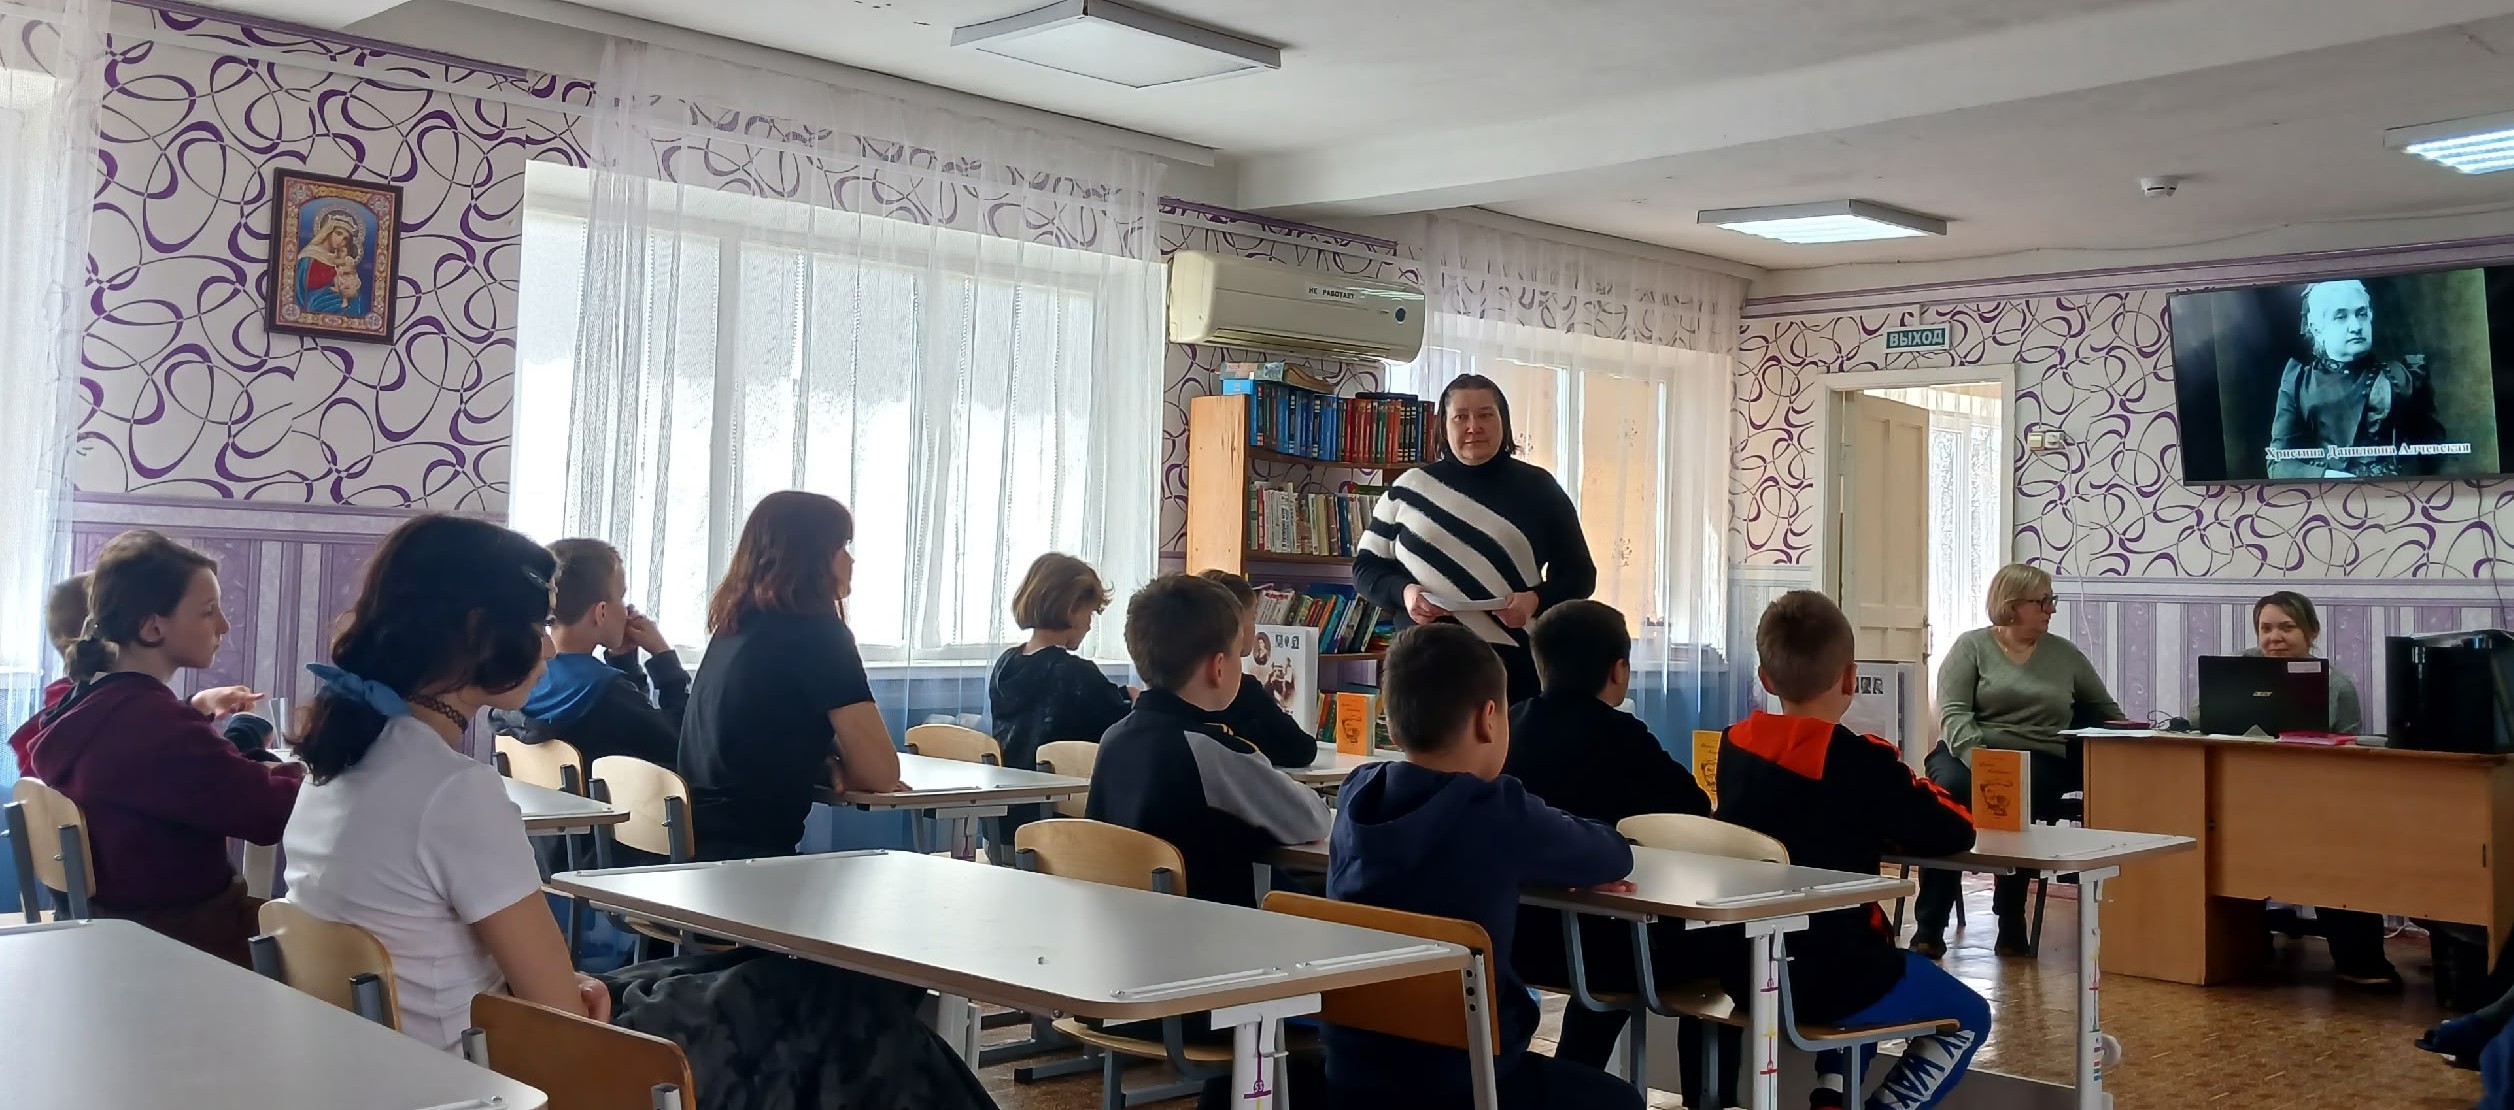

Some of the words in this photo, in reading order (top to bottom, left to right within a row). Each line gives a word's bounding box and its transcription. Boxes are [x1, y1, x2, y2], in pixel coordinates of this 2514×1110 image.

[1308, 287, 1318, 295] НЕ
[1322, 289, 1355, 299] РАБОТАЕТ
[1889, 329, 1944, 347] ВЫХОД
[2265, 447, 2325, 461] Христина
[2327, 445, 2397, 460] Даниловна
[2398, 443, 2471, 456] Алчевская
[1883, 1054, 1946, 1109] WAY
